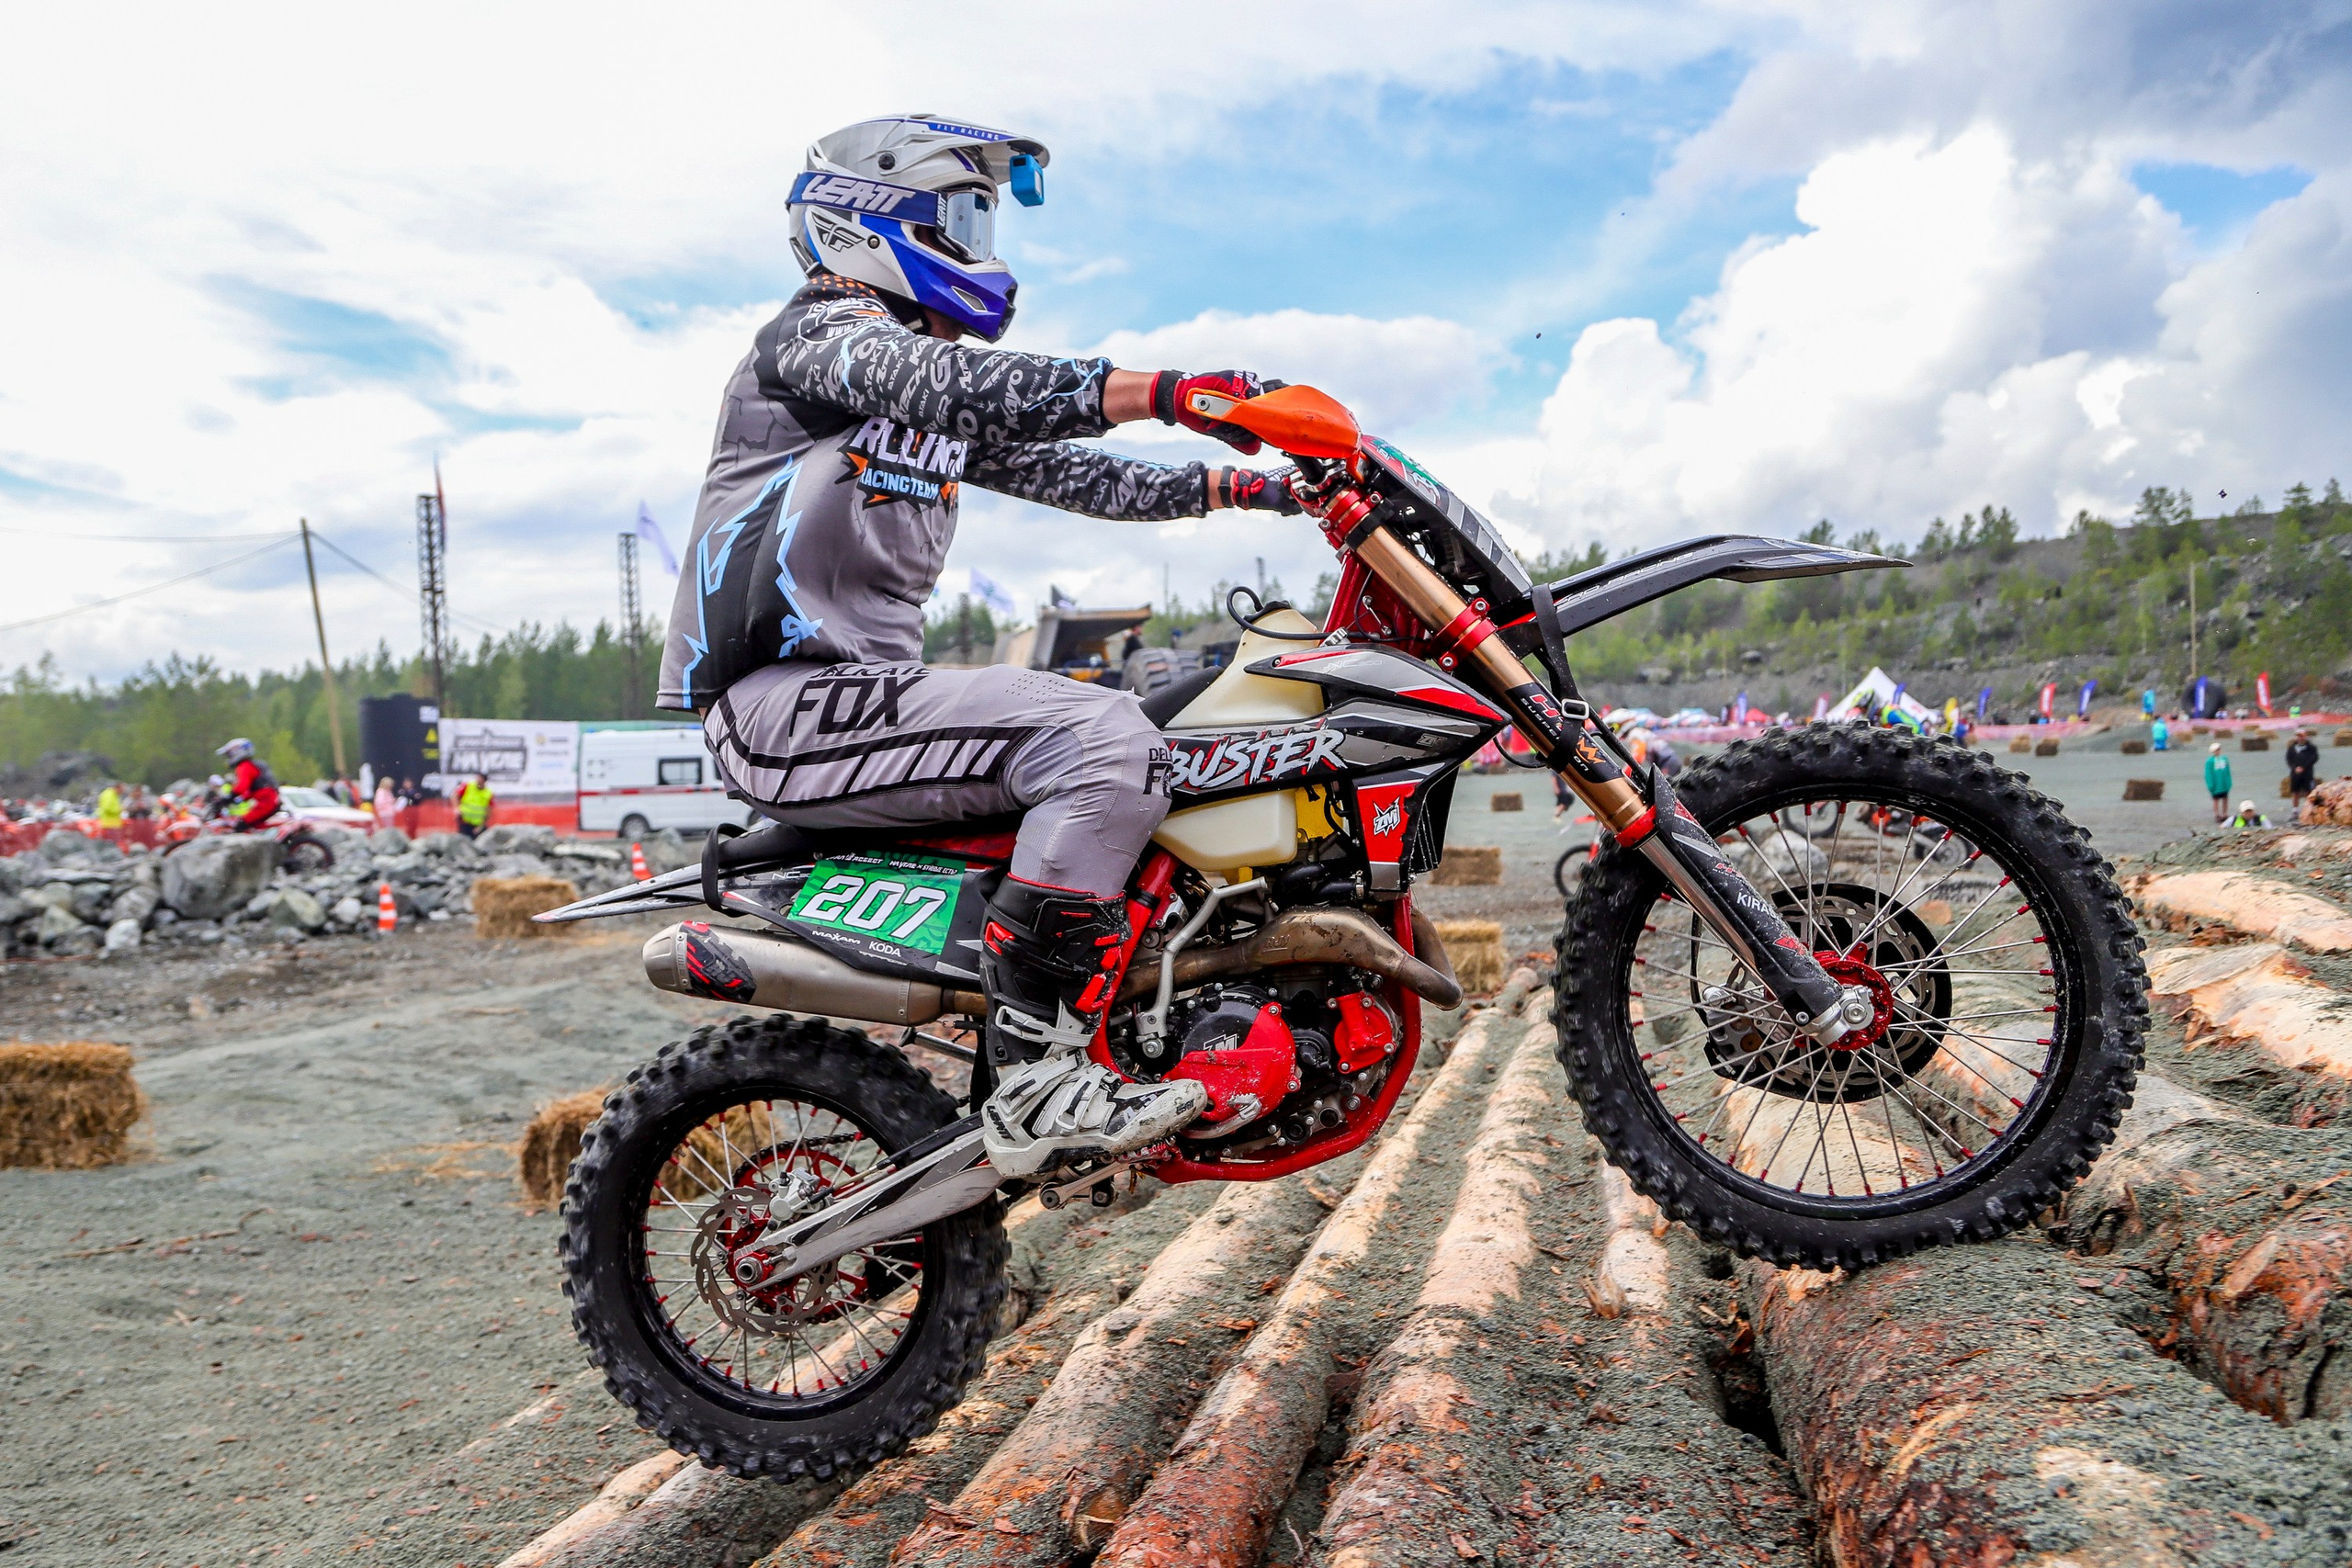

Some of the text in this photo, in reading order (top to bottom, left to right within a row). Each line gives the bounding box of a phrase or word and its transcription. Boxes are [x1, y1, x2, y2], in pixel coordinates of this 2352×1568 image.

[960, 126, 1000, 141] RACING
[801, 175, 917, 214] LEATT
[788, 675, 930, 738] FOX
[1170, 723, 1348, 790] BUSTER
[797, 874, 947, 940] 207
[812, 930, 861, 944] MAXAM
